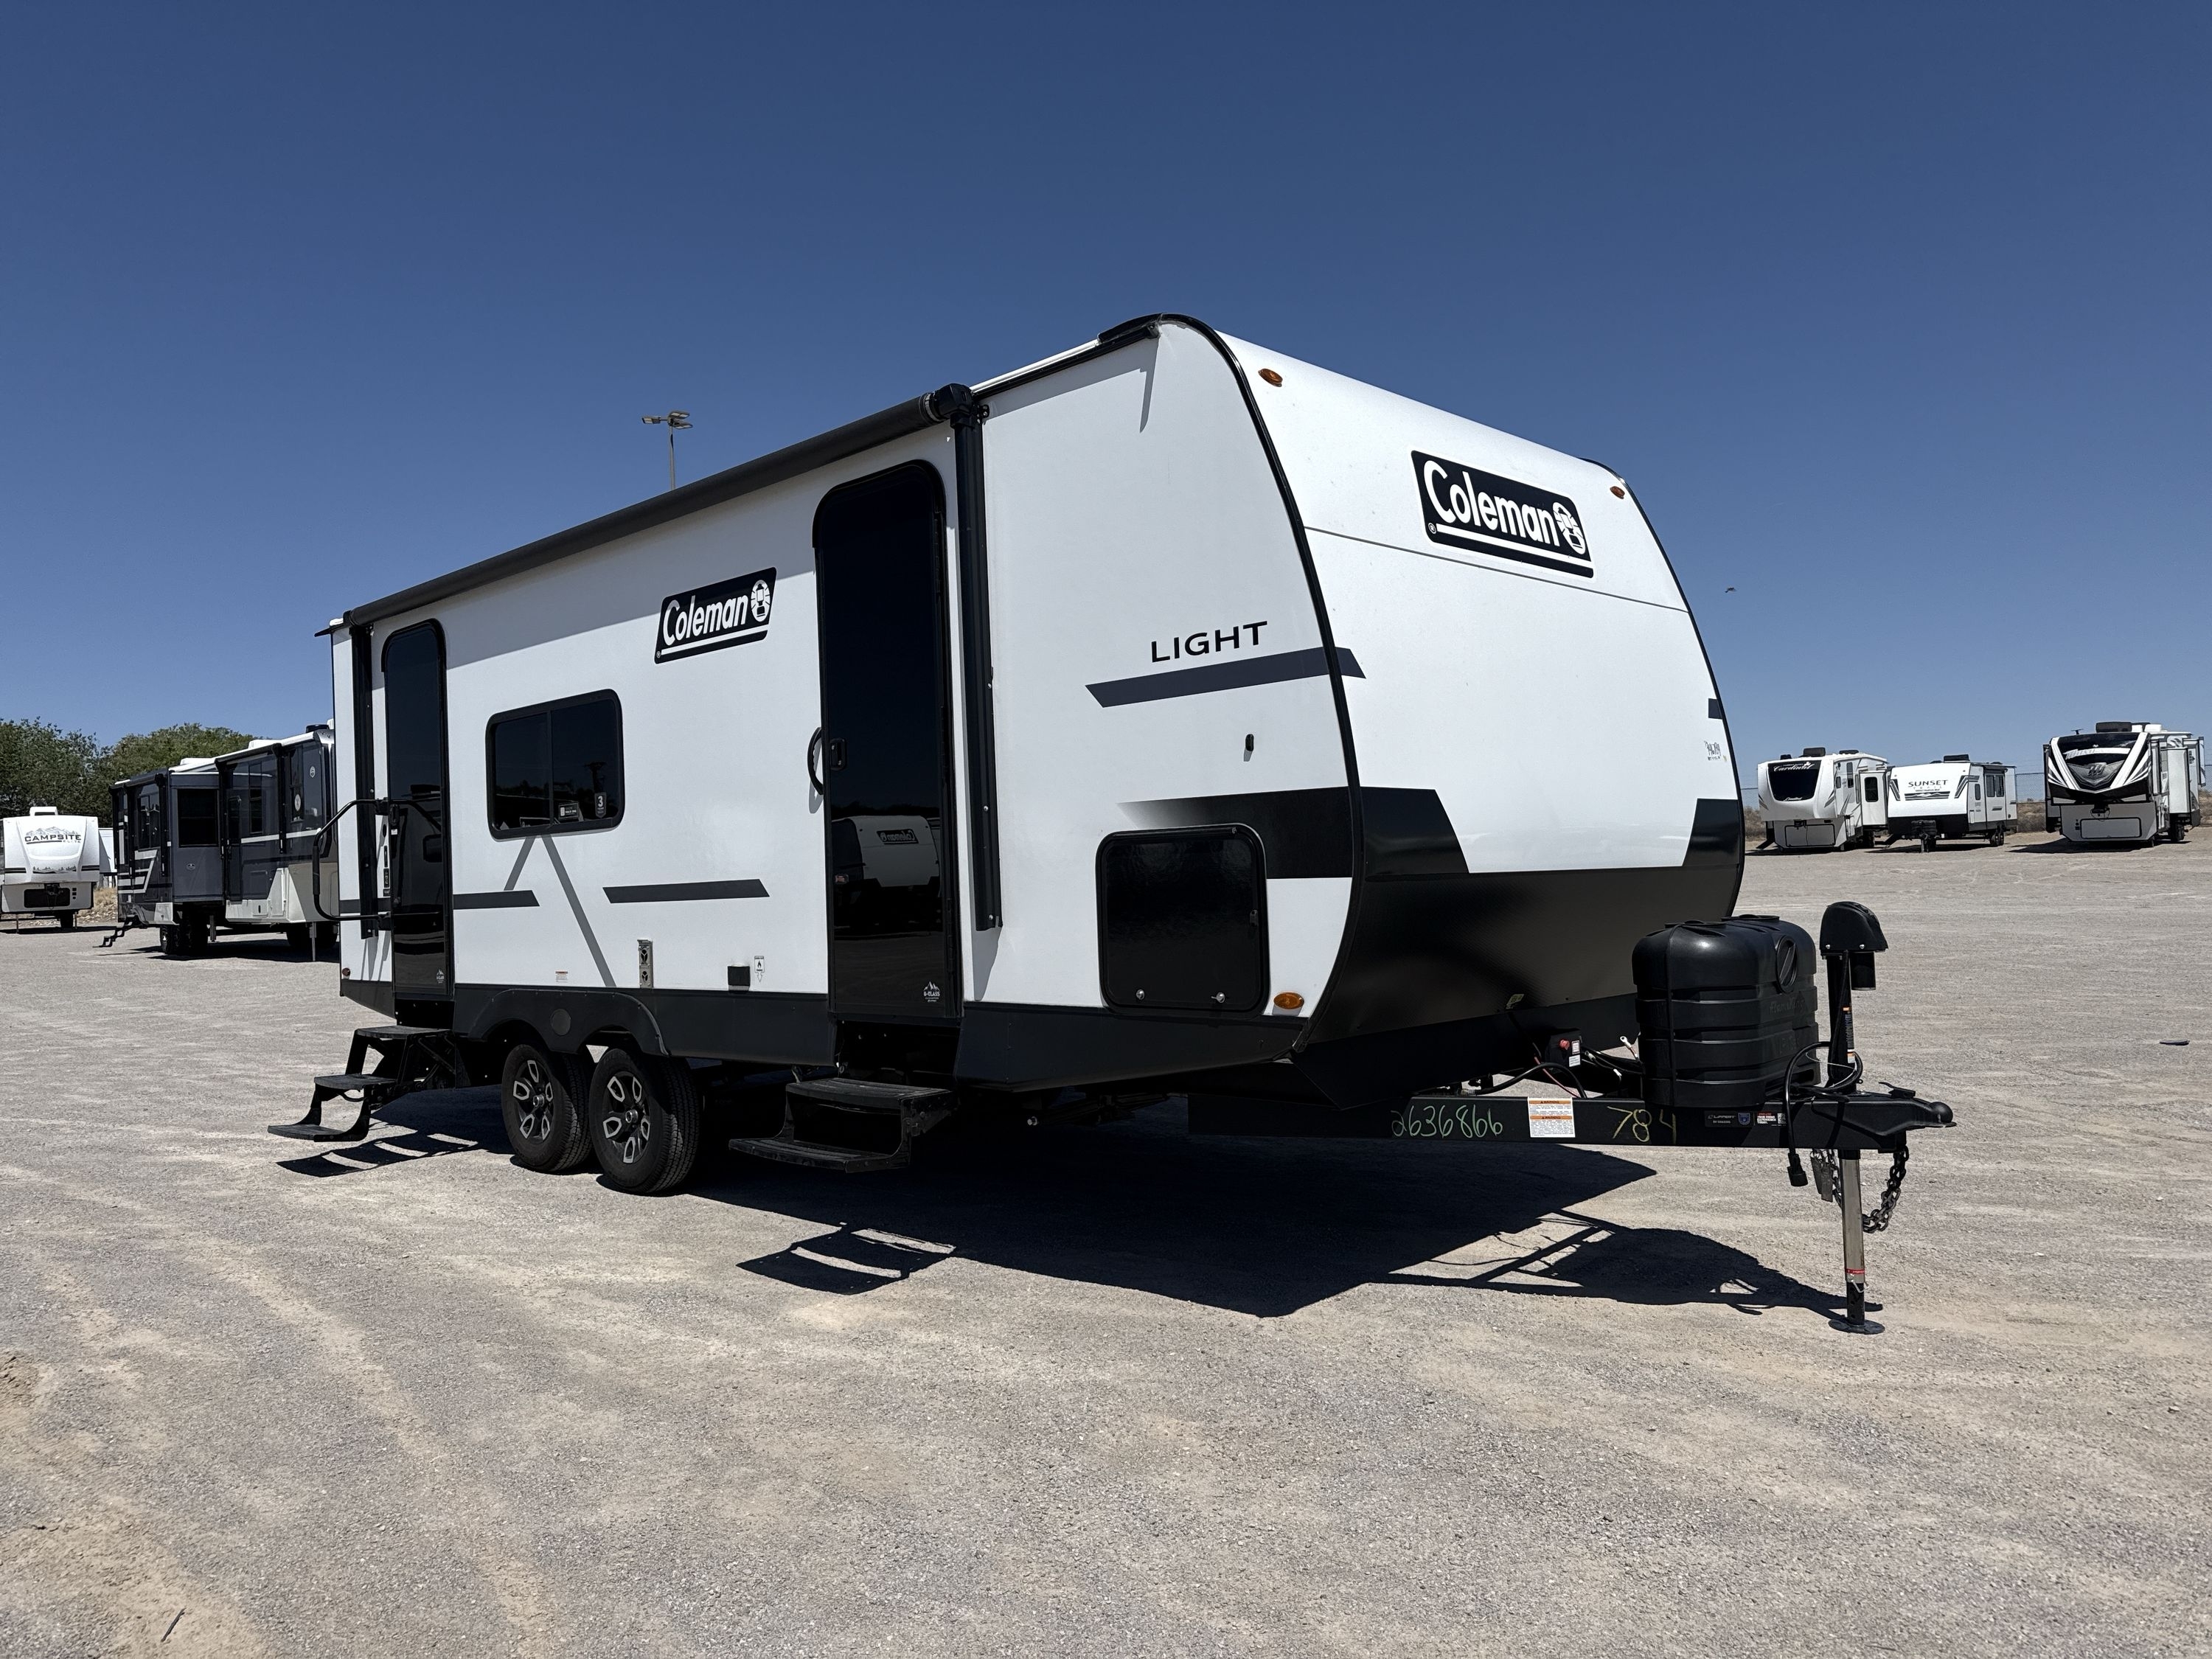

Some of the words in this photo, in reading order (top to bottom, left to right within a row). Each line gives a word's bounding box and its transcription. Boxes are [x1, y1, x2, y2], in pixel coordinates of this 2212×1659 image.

[1423, 459, 1560, 547] Coleman
[663, 594, 748, 646] Coleman
[1151, 620, 1267, 663] LIGHT
[1907, 779, 1948, 788] SUNSET
[597, 795, 604, 808] 3
[24, 834, 82, 842] CAMPSITE
[1390, 1104, 1503, 1139] 2636866
